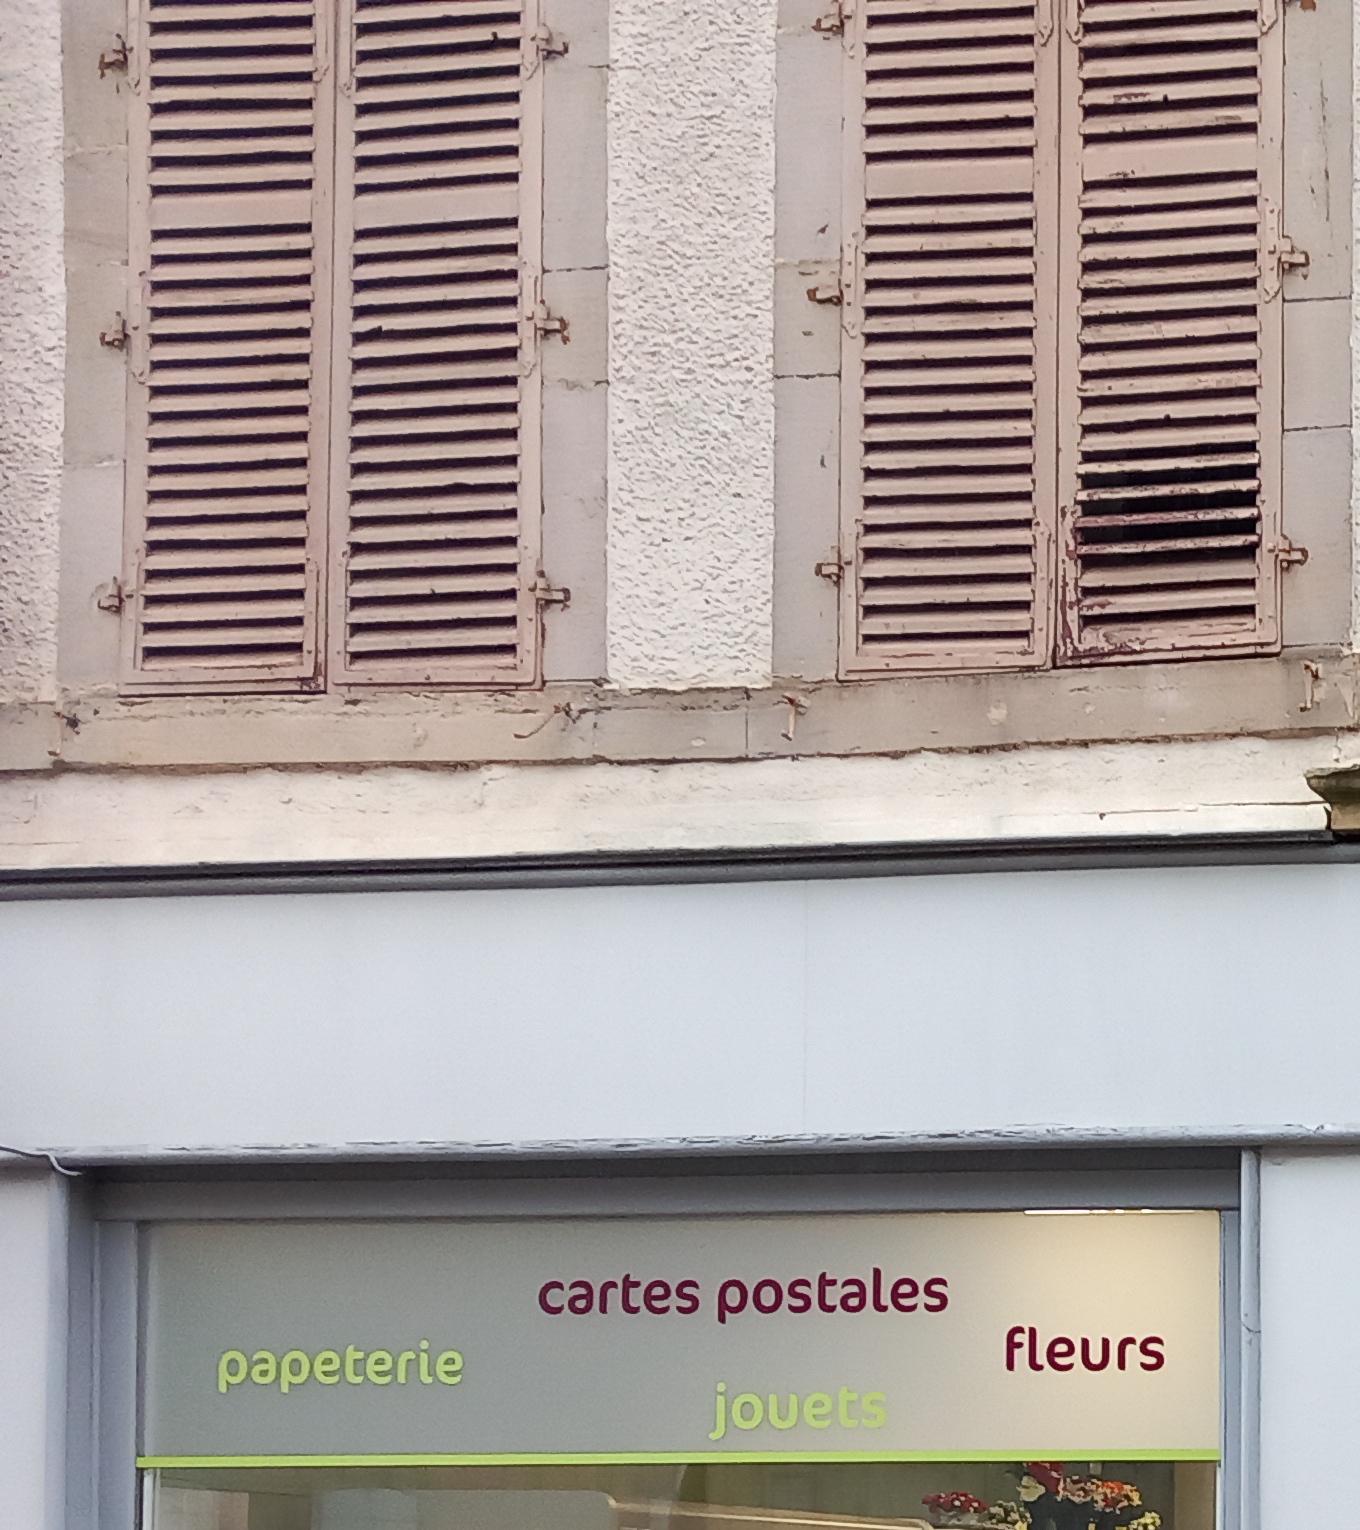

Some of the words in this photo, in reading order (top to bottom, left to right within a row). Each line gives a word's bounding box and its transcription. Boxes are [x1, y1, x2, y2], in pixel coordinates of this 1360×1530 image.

[538, 1273, 700, 1315] cartes
[717, 1267, 949, 1324] postales
[218, 1339, 464, 1393] papeterie
[1005, 1326, 1165, 1371] fleurs
[709, 1382, 887, 1441] jouets
